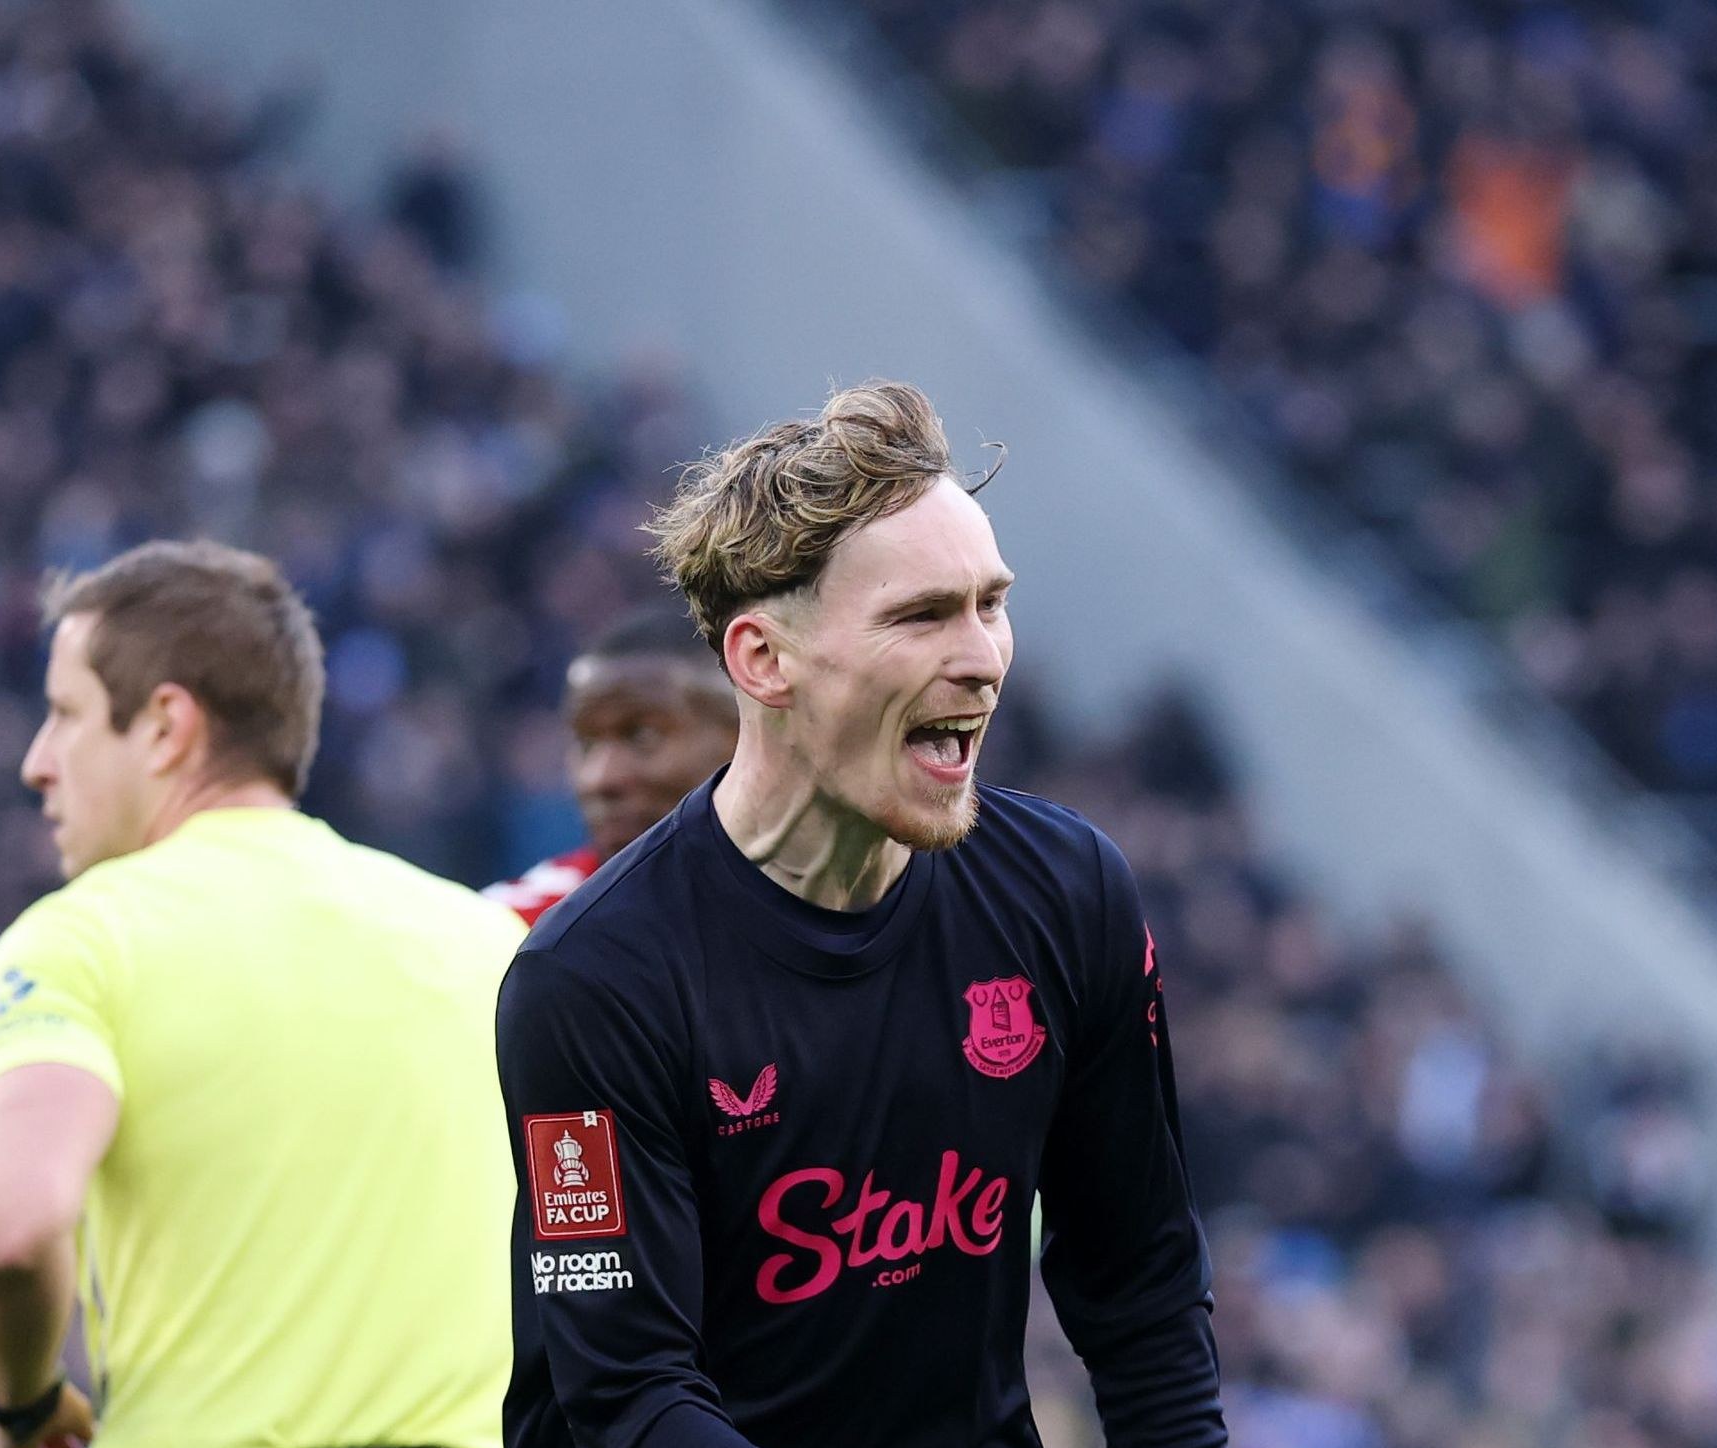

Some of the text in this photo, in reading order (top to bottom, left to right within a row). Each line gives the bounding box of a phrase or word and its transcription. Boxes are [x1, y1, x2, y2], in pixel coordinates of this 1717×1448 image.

[981, 1033, 1026, 1050] Everton
[717, 1112, 780, 1136] CASTORE
[544, 1190, 607, 1206] Emirates
[546, 1204, 609, 1225] FA CUP
[756, 1150, 1009, 1305] Stake
[559, 1251, 621, 1273] room
[557, 1270, 634, 1292] racism
[872, 1262, 921, 1288] .com
